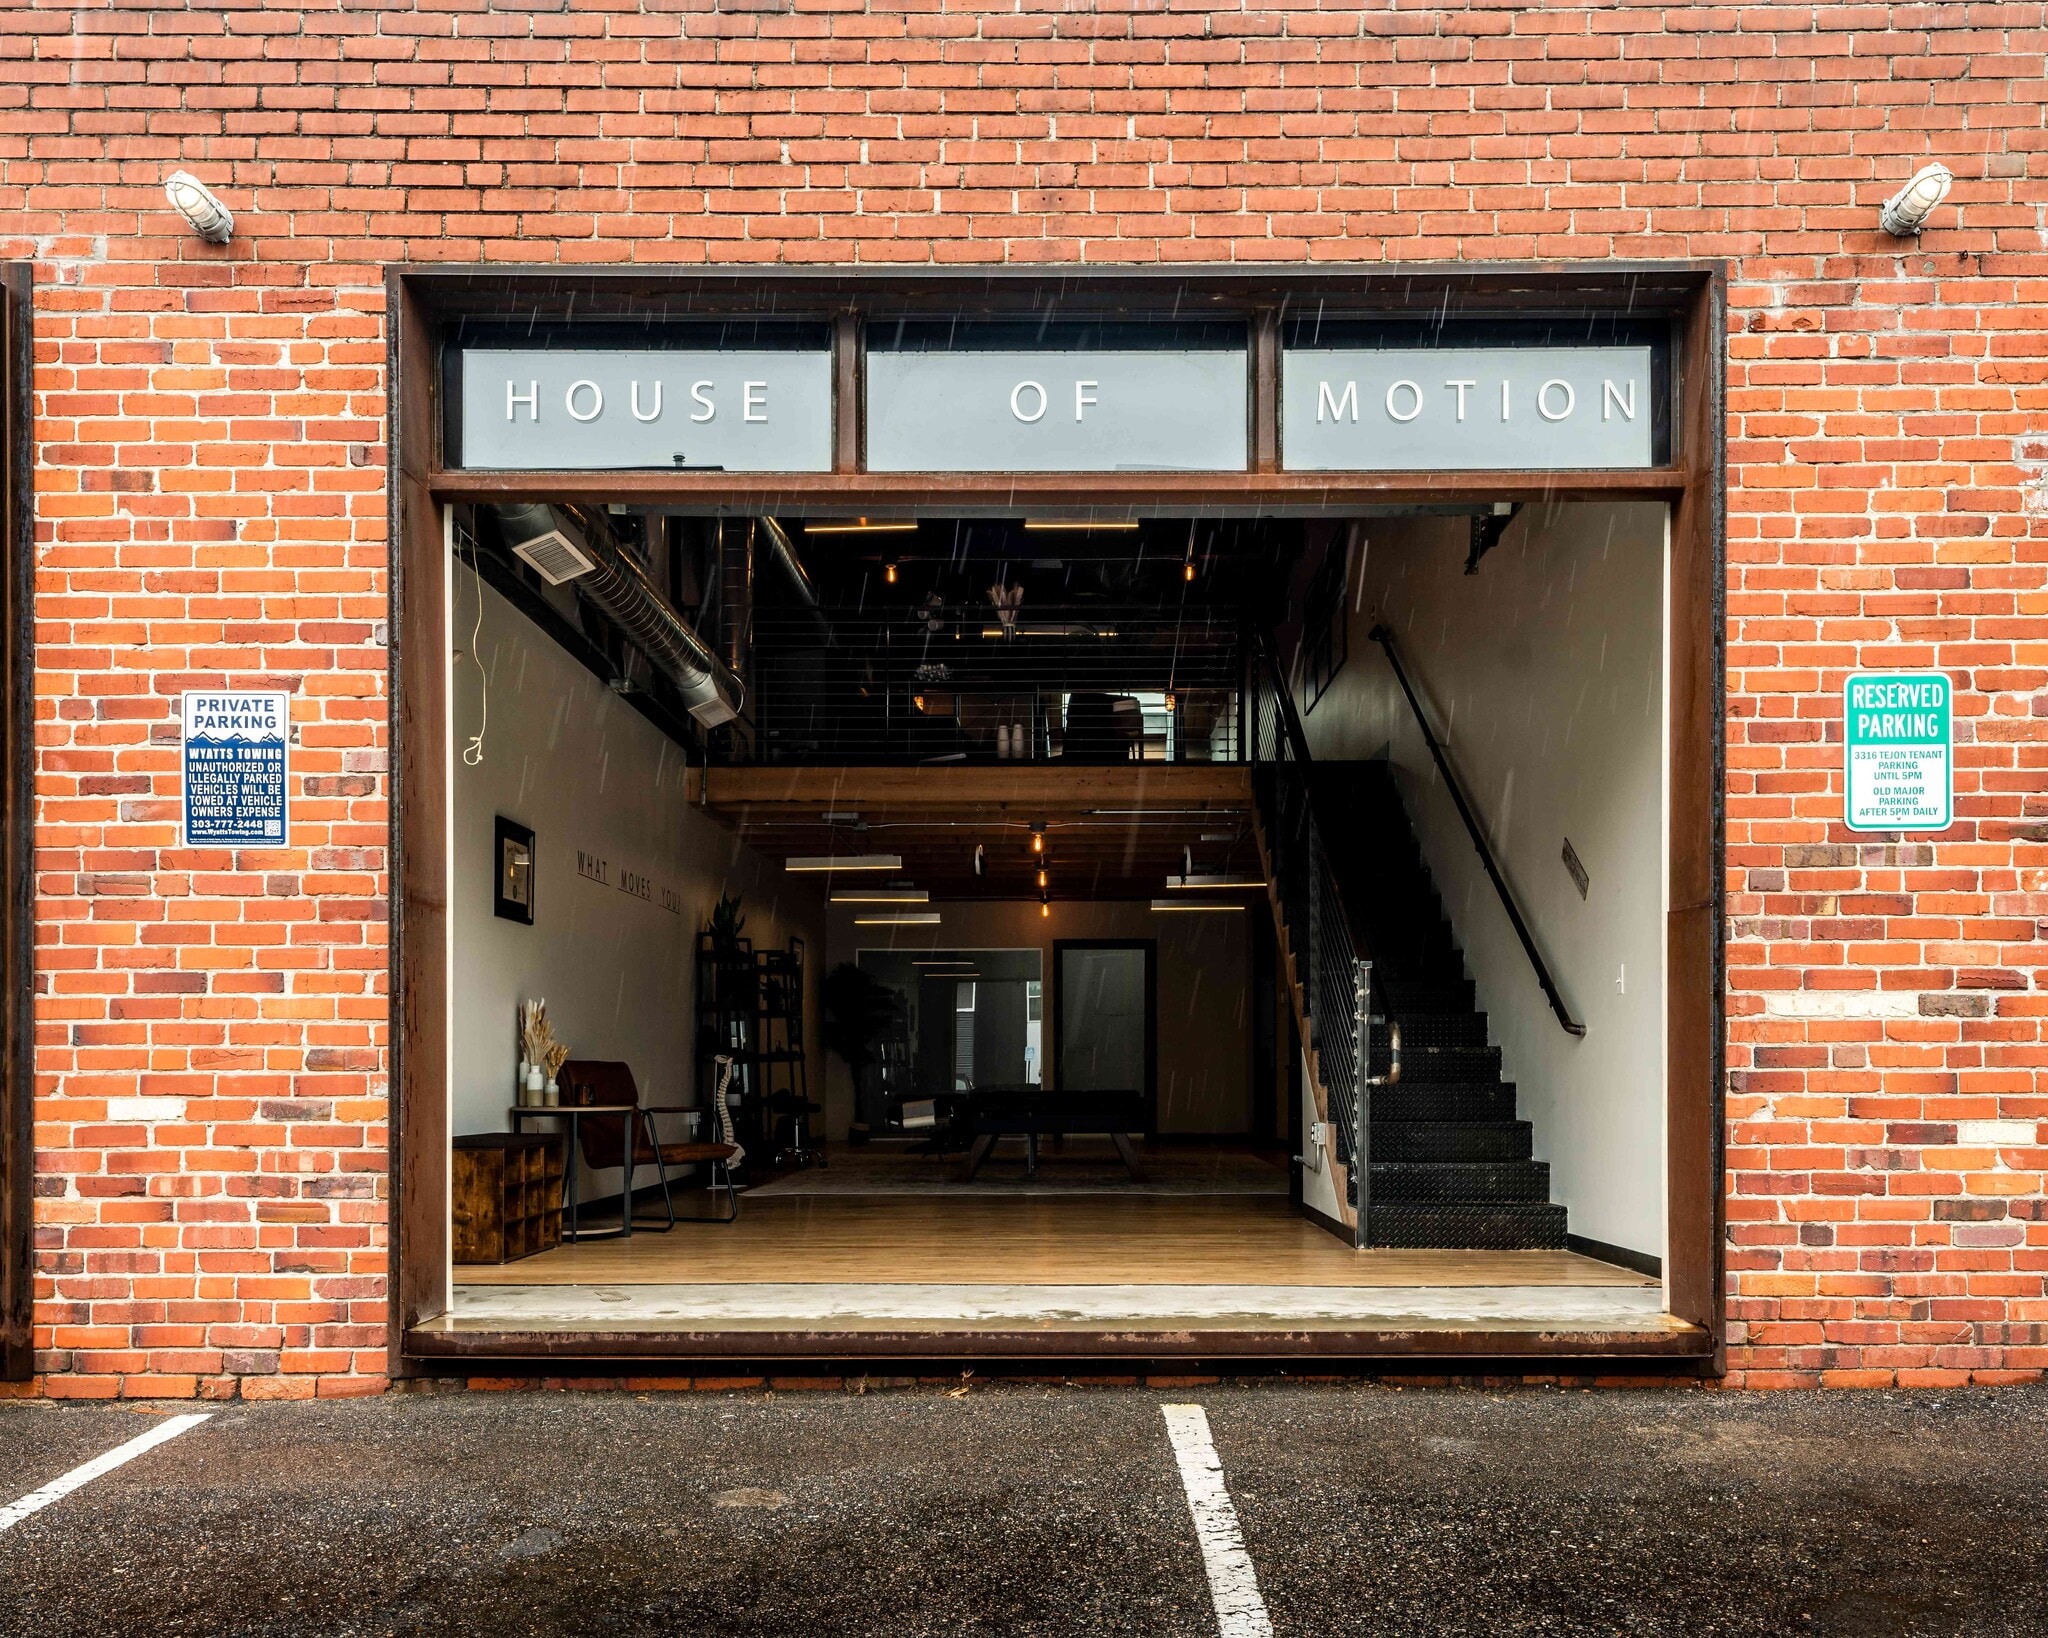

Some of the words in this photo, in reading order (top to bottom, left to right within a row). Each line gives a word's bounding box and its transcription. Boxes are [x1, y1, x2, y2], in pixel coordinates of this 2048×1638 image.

[505, 379, 770, 423] HOUSE
[1009, 379, 1100, 423] OF
[1316, 378, 1636, 424] MOTION
[1853, 684, 1944, 708] RESERVED
[197, 699, 274, 712] PRIVATE
[194, 716, 277, 728] PARKING
[1858, 713, 1939, 738] PARKING
[189, 748, 233, 760] WYATTS
[237, 748, 282, 760] TOWING
[1854, 751, 1877, 760] 3316
[1880, 751, 1907, 760] TEJON
[1909, 750, 1943, 759] TENANT
[189, 762, 264, 772] UNAUTHORIZED
[267, 762, 281, 772] OR
[1878, 761, 1919, 770] PARKING
[189, 773, 240, 783] ILLEGALLY
[244, 773, 282, 783] PARKED
[1874, 771, 1899, 780] UNTIL
[1902, 771, 1923, 780] 5PM
[190, 784, 238, 795] VEHICLES
[241, 784, 264, 795] WILL
[268, 785, 281, 795] BE
[1873, 787, 1891, 796] OLD
[1893, 786, 1925, 796] MAJOR
[189, 795, 223, 806] TOWED
[226, 795, 238, 806] AT
[241, 795, 282, 806] VEHICLE
[1879, 797, 1919, 806] PARKING
[191, 806, 233, 817] OWNERS
[236, 806, 281, 817] EXPENSE
[1859, 808, 1887, 817] AFTER
[1890, 808, 1910, 816] 5PM
[1913, 807, 1939, 816] DAILY
[191, 820, 263, 828] 303-777-2448
[577, 850, 607, 882] WHAT
[621, 868, 651, 899] MOVES
